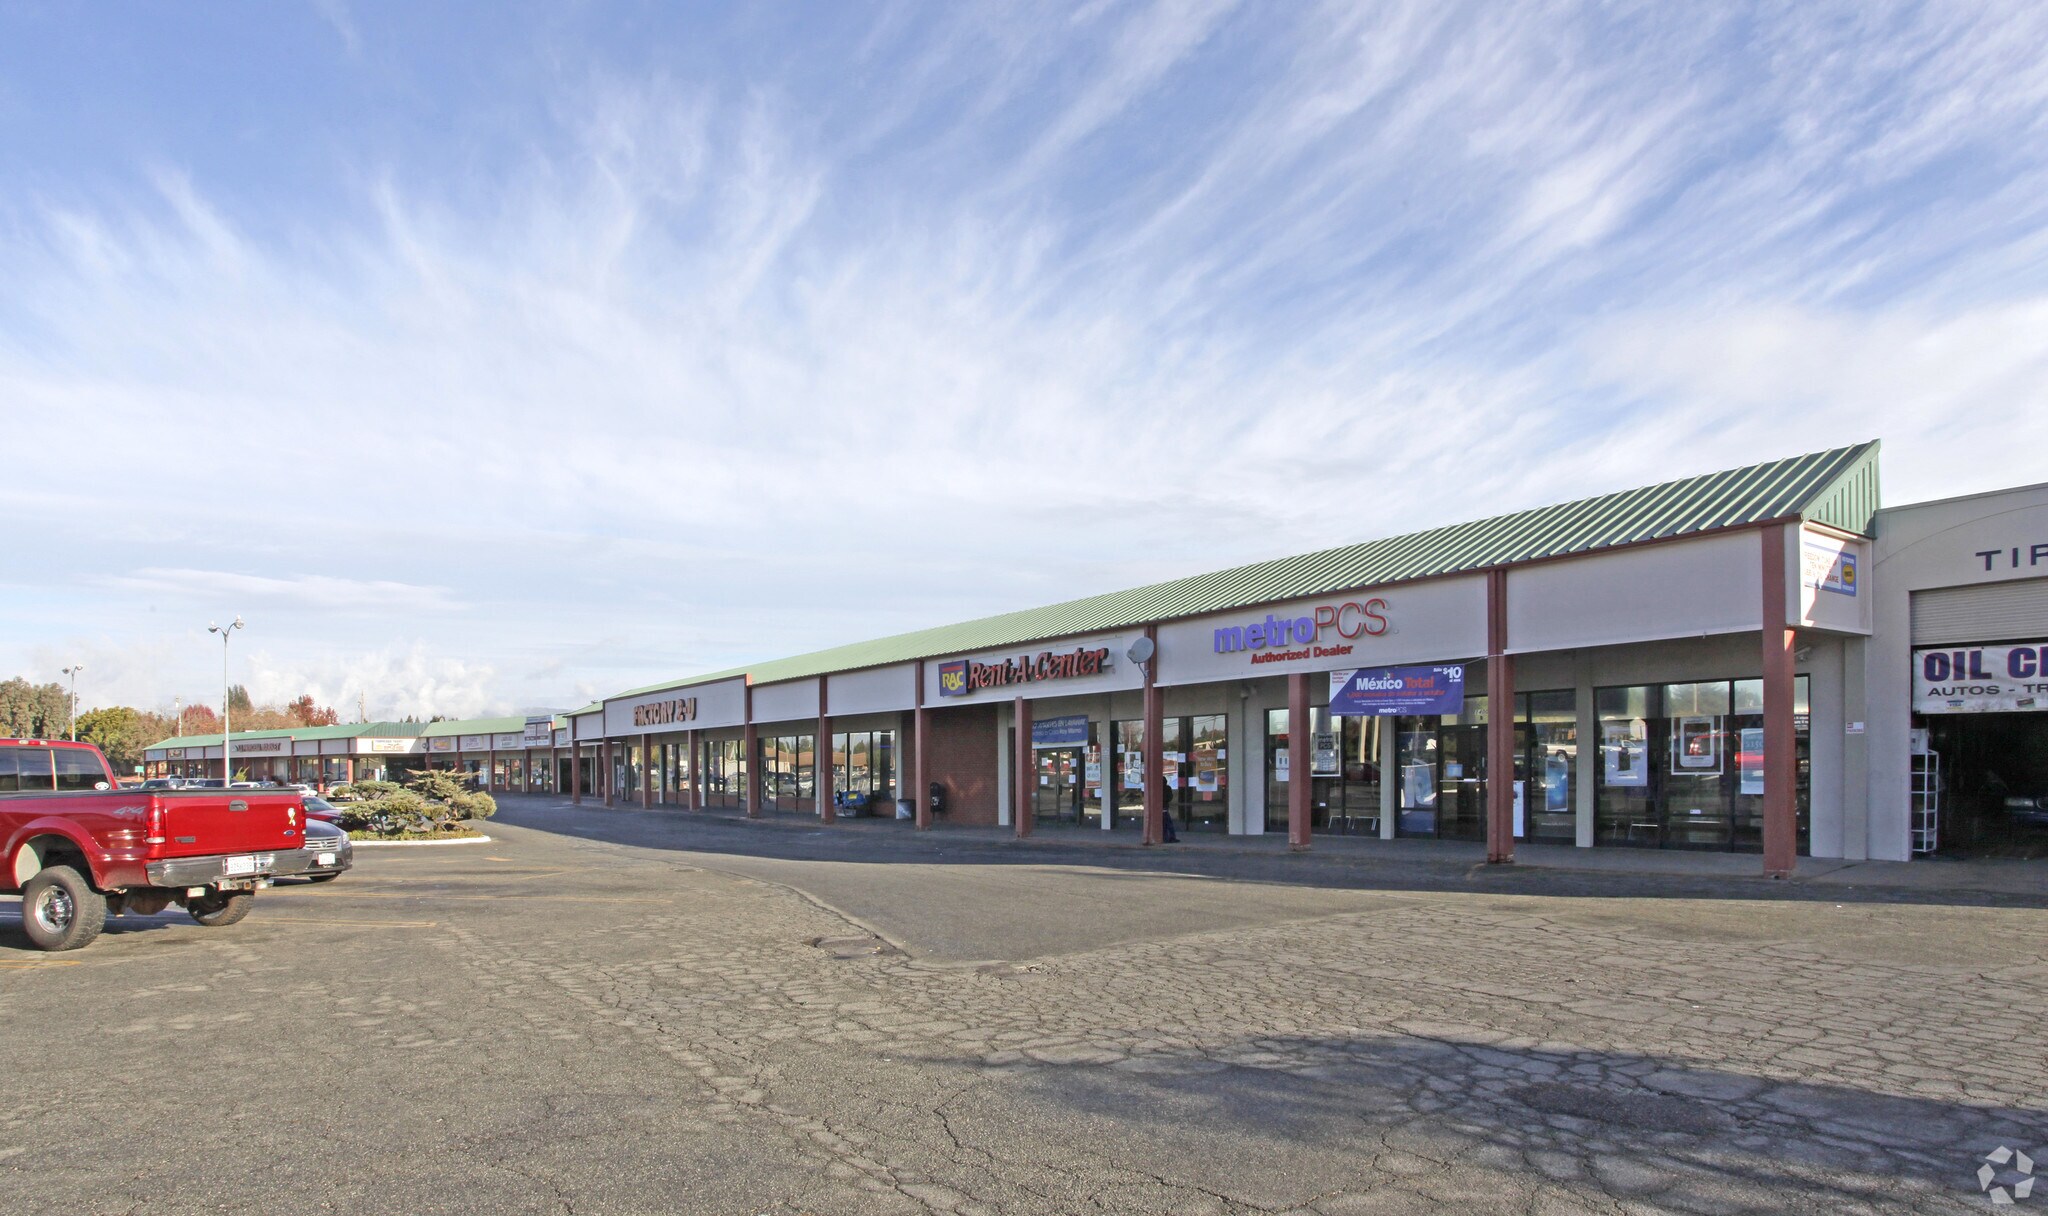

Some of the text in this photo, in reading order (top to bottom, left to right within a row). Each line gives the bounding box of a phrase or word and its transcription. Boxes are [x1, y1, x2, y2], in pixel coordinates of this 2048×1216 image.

[1214, 598, 1388, 653] metroPCS
[1251, 644, 1353, 664] Authorized Dealer
[1442, 666, 1462, 679] $10
[1924, 650, 1993, 682] OIL
[942, 671, 964, 691] RAC
[1356, 675, 1434, 691] México Total
[1928, 685, 2000, 697] AUTOS
[634, 697, 697, 726] FACTORY 2-U
